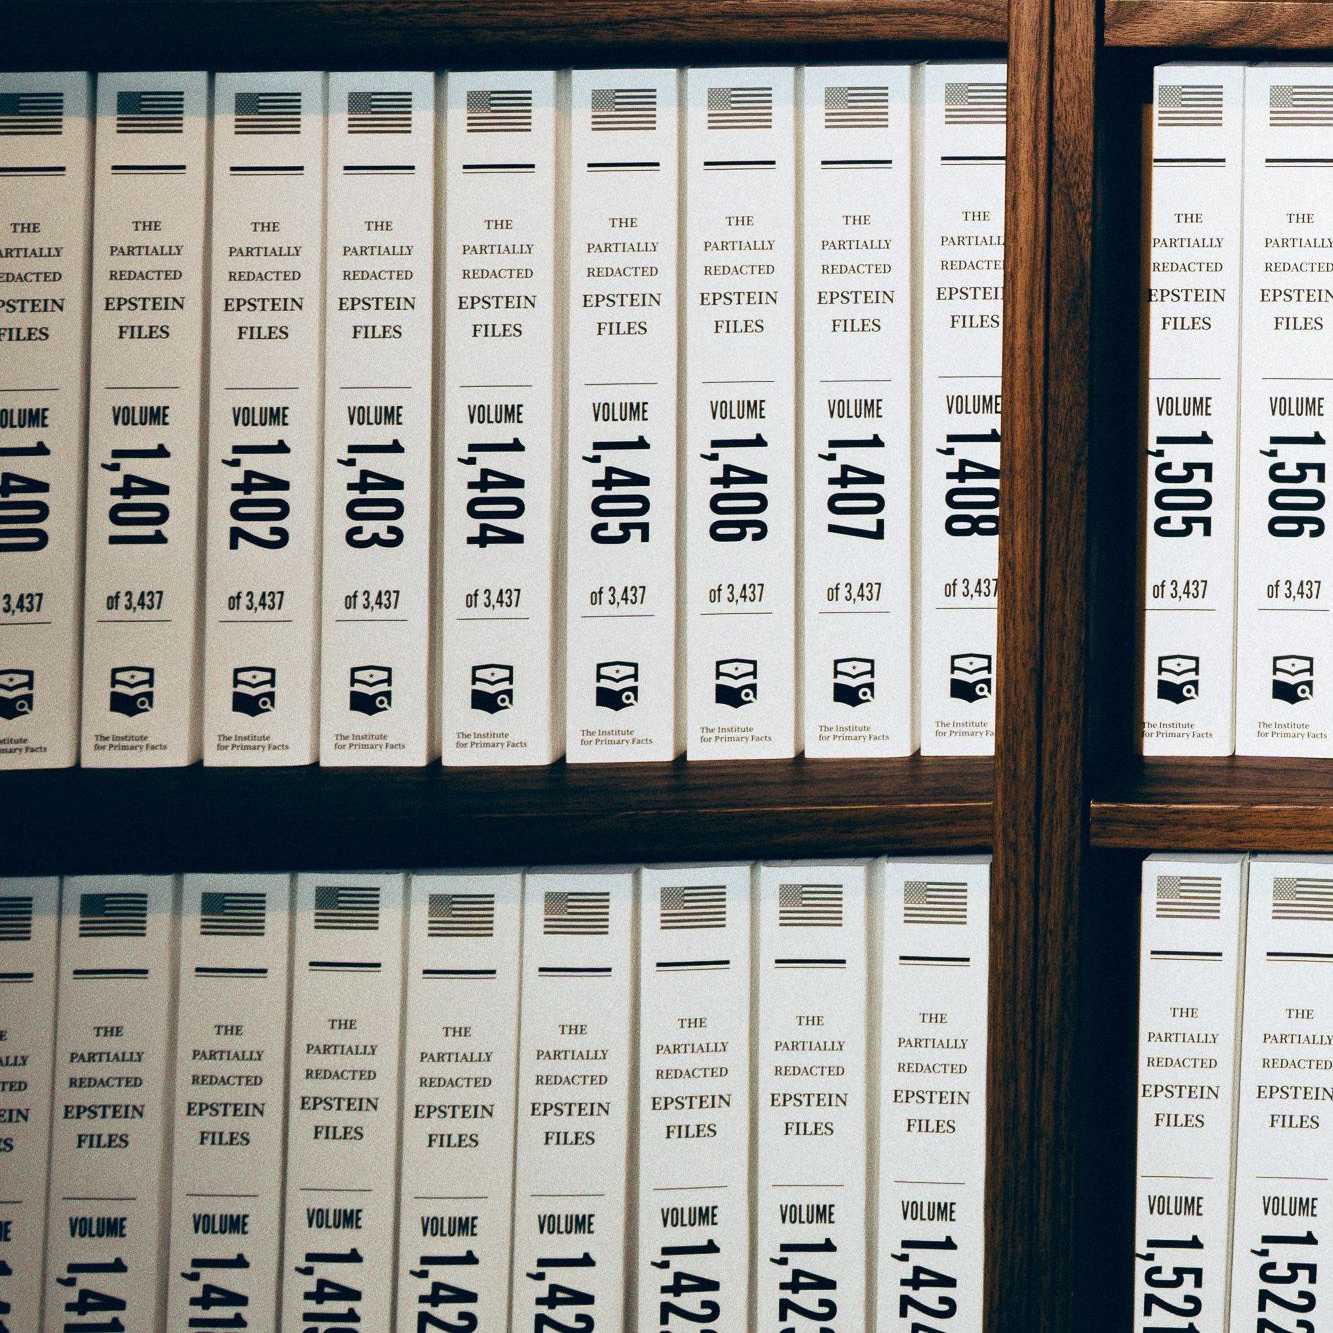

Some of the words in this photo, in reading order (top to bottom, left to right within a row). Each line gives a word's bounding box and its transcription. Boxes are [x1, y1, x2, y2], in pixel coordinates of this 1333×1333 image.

[221, 439, 291, 551] 1,402
[457, 437, 526, 549] 1,404
[700, 433, 769, 543] 1,406
